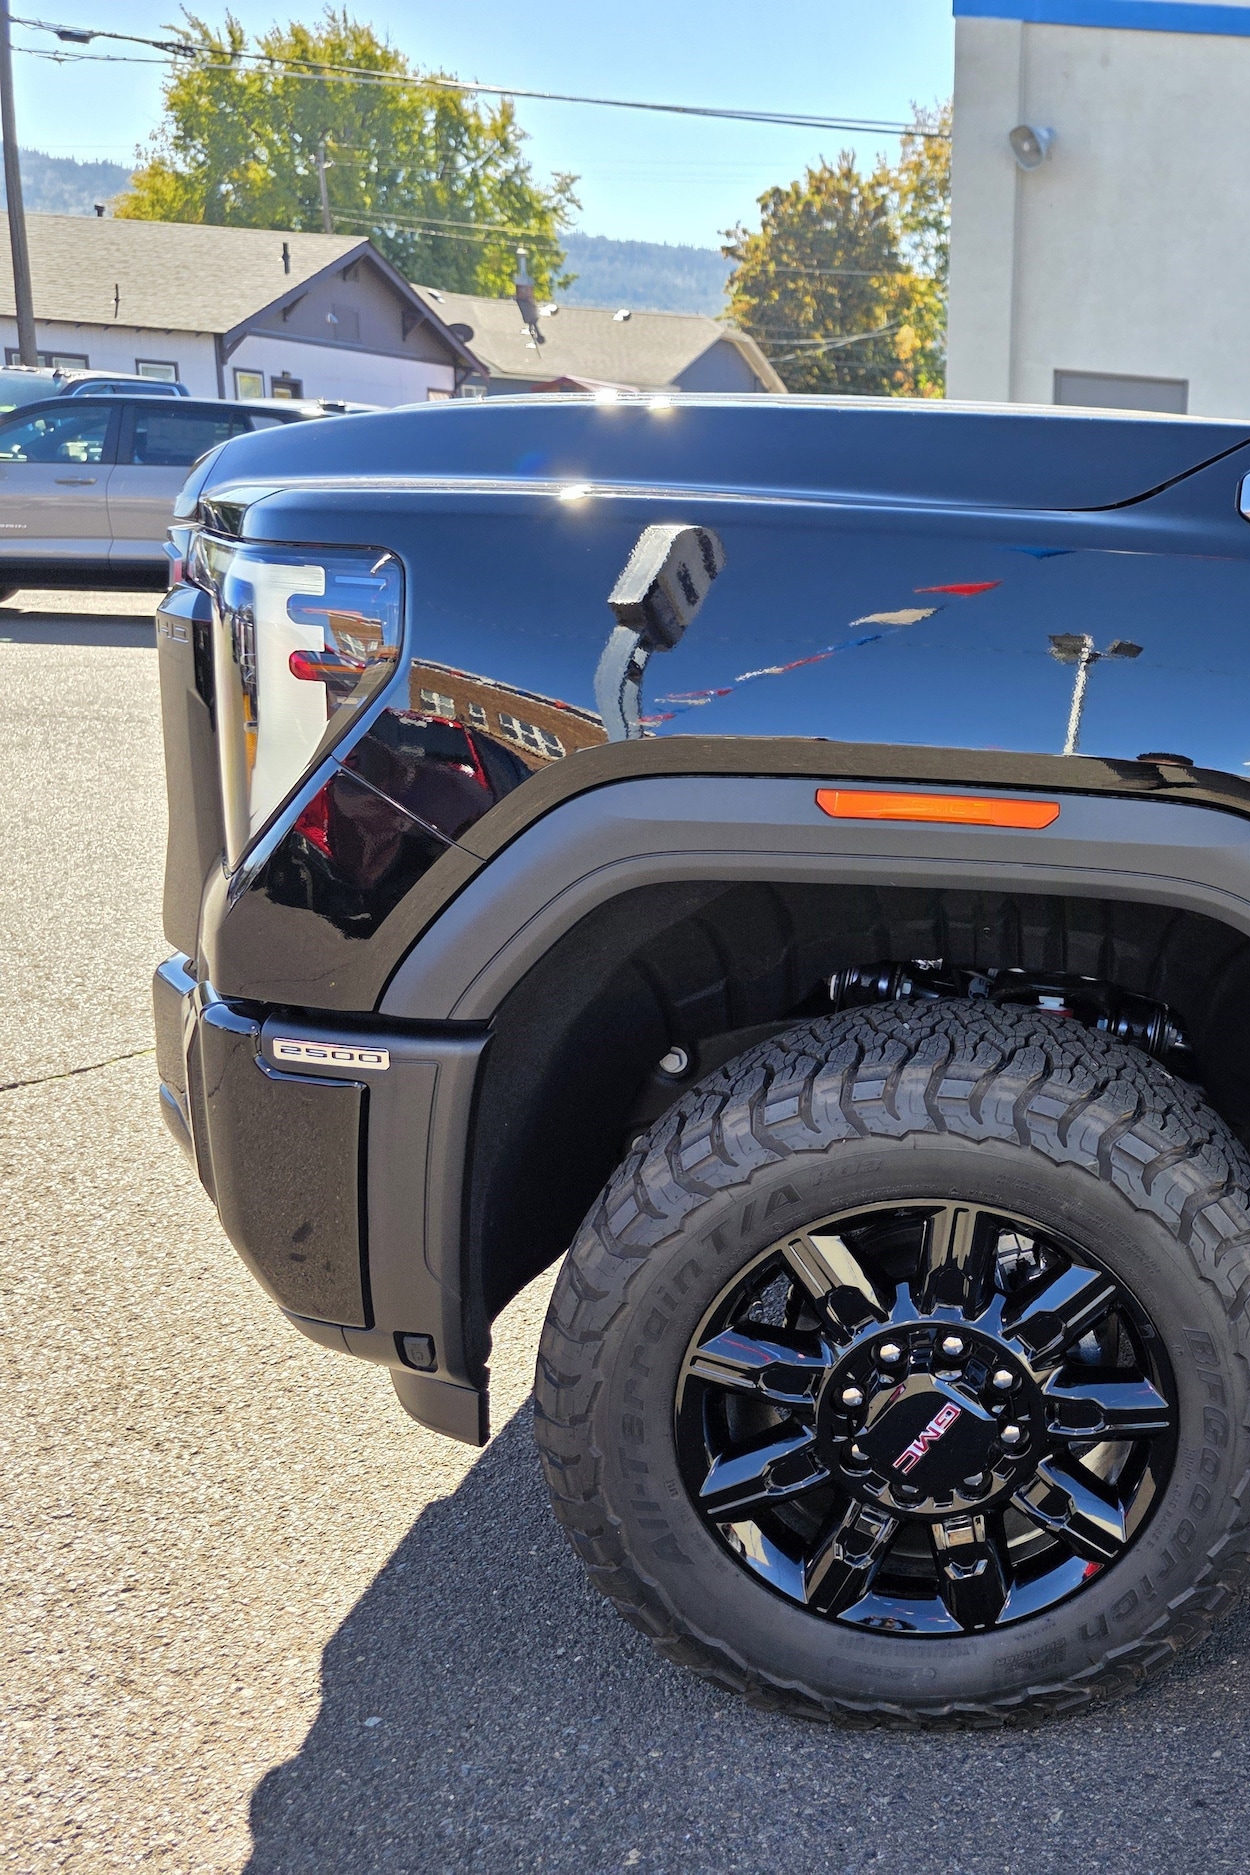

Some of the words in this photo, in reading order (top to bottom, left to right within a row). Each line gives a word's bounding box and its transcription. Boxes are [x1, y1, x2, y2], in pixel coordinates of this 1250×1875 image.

[280, 1045, 382, 1063] 2500
[892, 1401, 961, 1475] GMC
[1078, 1327, 1230, 1642] BFGoodrich
